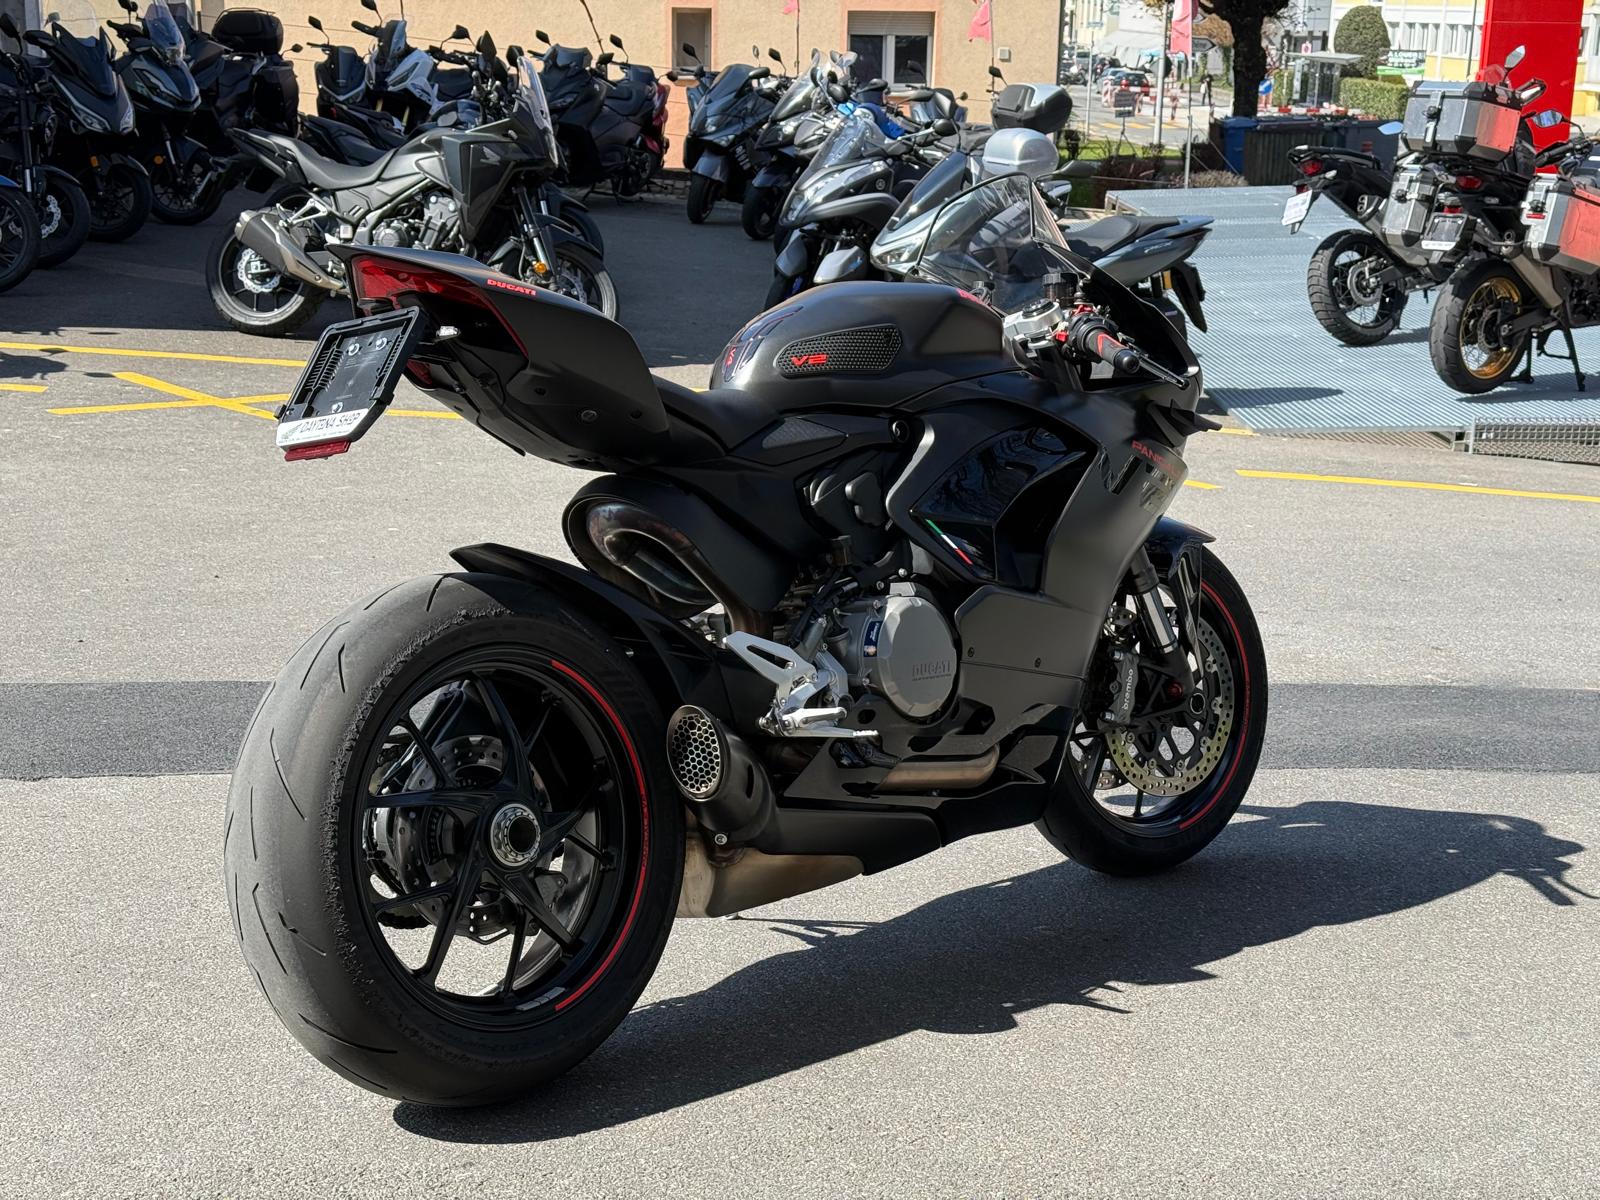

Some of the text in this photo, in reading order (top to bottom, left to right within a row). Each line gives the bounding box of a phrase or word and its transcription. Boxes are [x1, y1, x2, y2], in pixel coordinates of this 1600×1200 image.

[487, 279, 536, 296] DUCATI
[791, 353, 828, 367] V2
[912, 660, 951, 677] DUCATI
[1121, 668, 1134, 710] brembo
